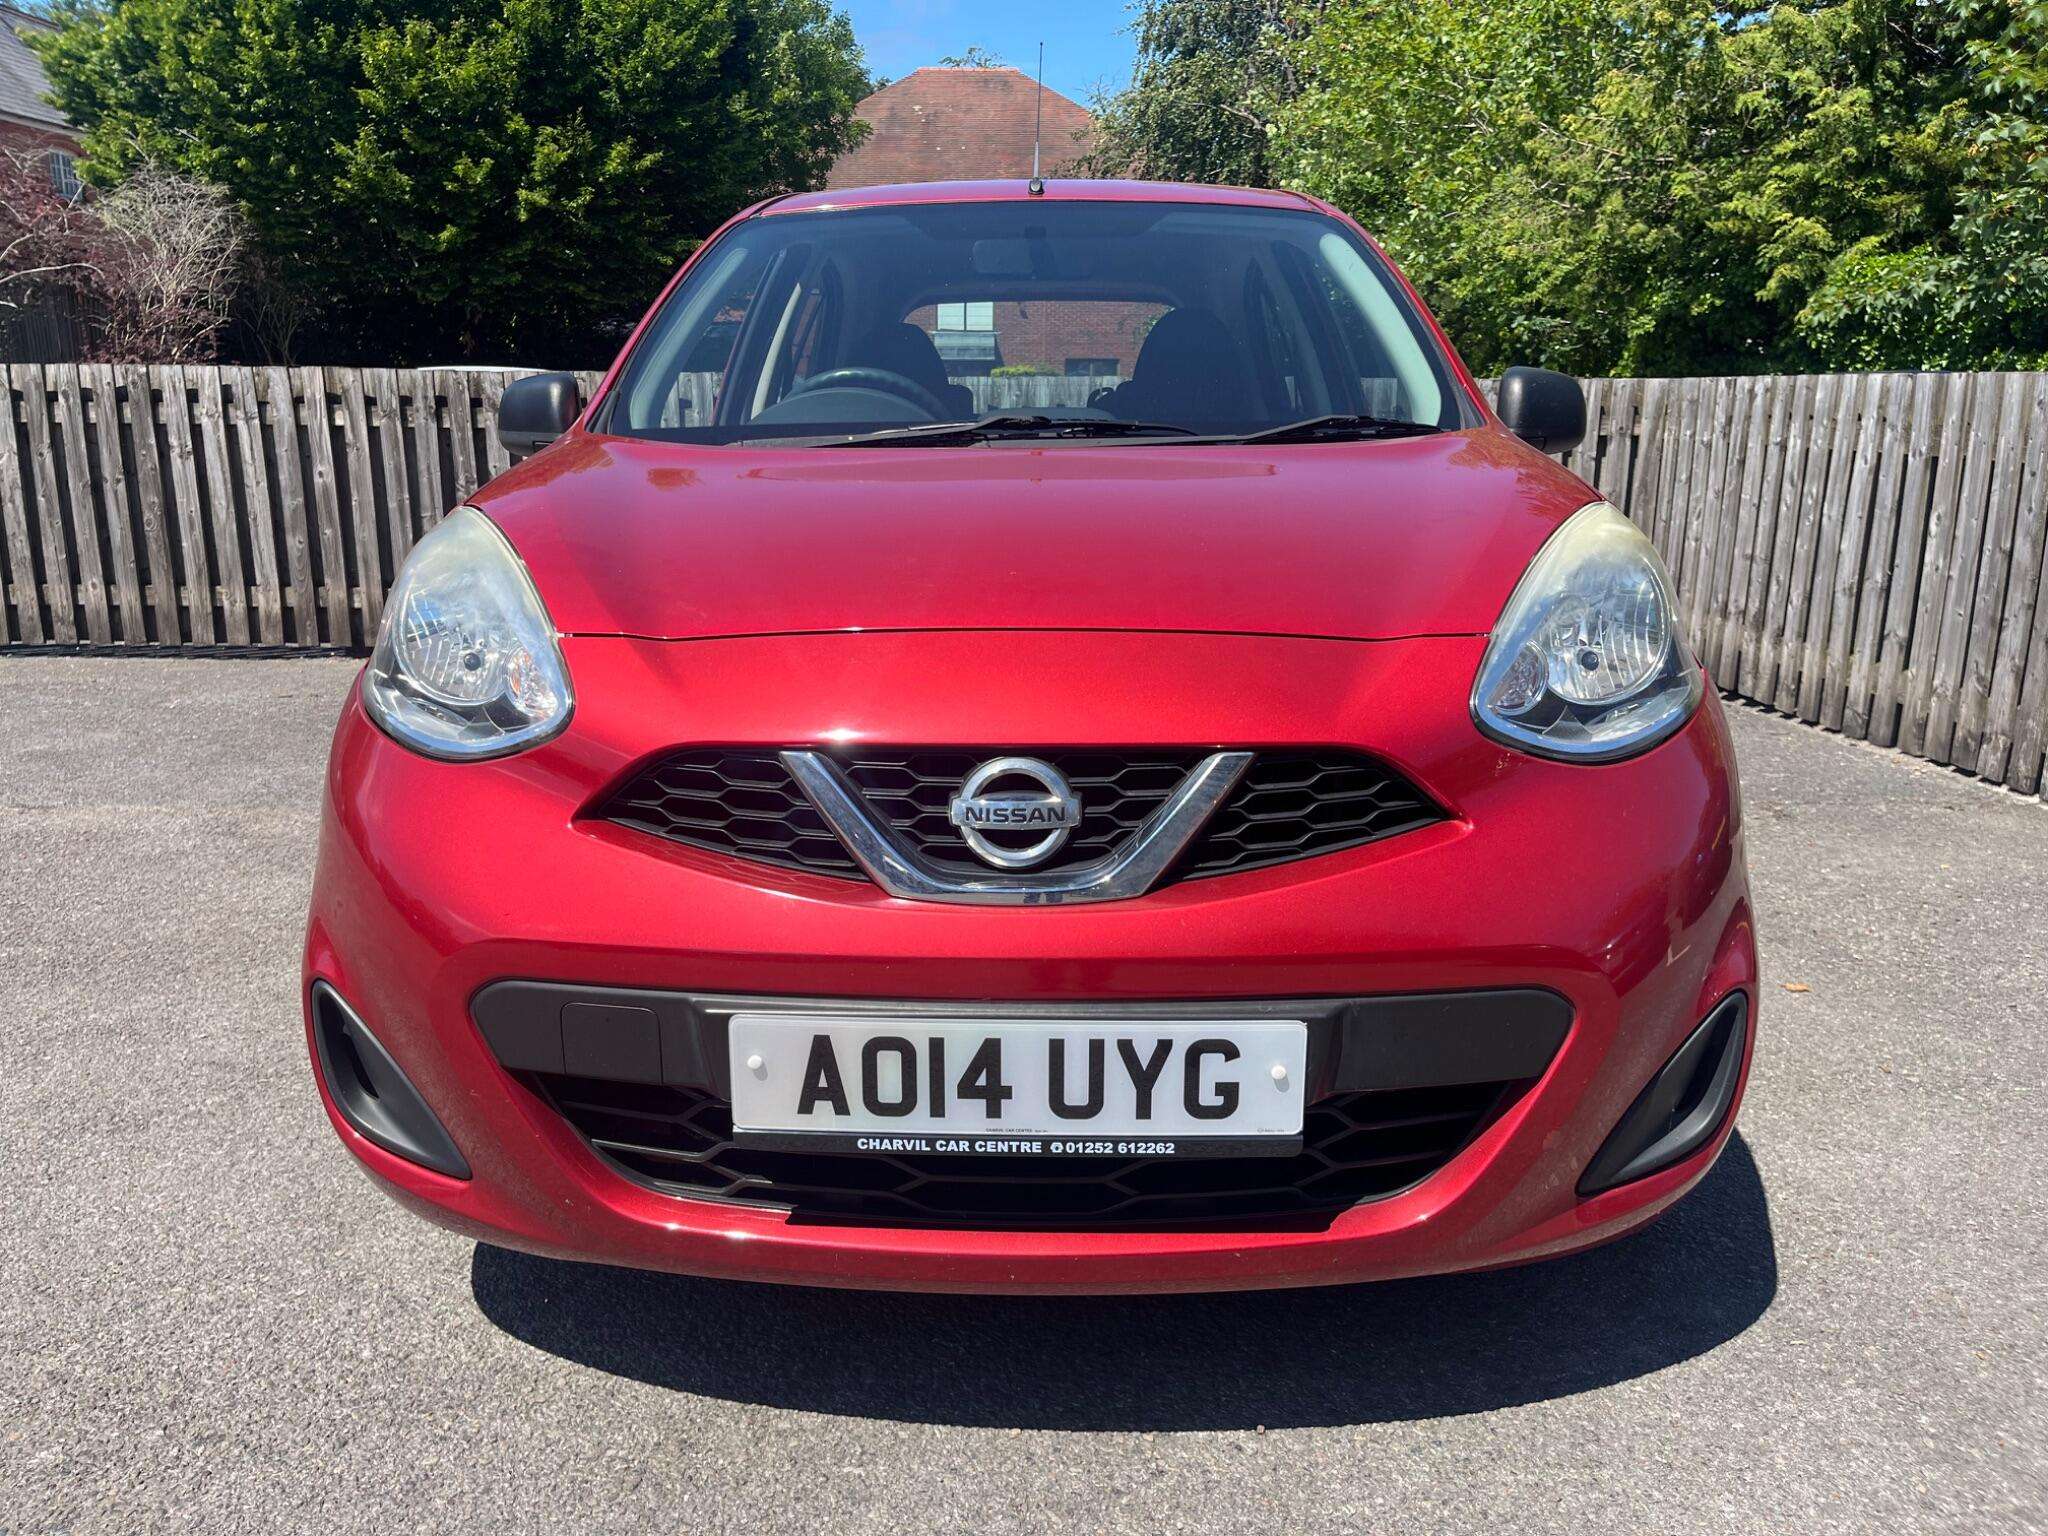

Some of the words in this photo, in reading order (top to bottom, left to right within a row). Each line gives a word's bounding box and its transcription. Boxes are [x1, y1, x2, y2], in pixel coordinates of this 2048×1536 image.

[964, 806, 1066, 823] NISSAN
[797, 1034, 1013, 1119] AO14
[1048, 1038, 1241, 1120] UYG
[857, 1138, 931, 1151] CHARVIL
[935, 1140, 970, 1152] CAR
[974, 1141, 1042, 1153] CENTRE
[1066, 1142, 1114, 1154] 01252
[1117, 1142, 1175, 1154] 612262
